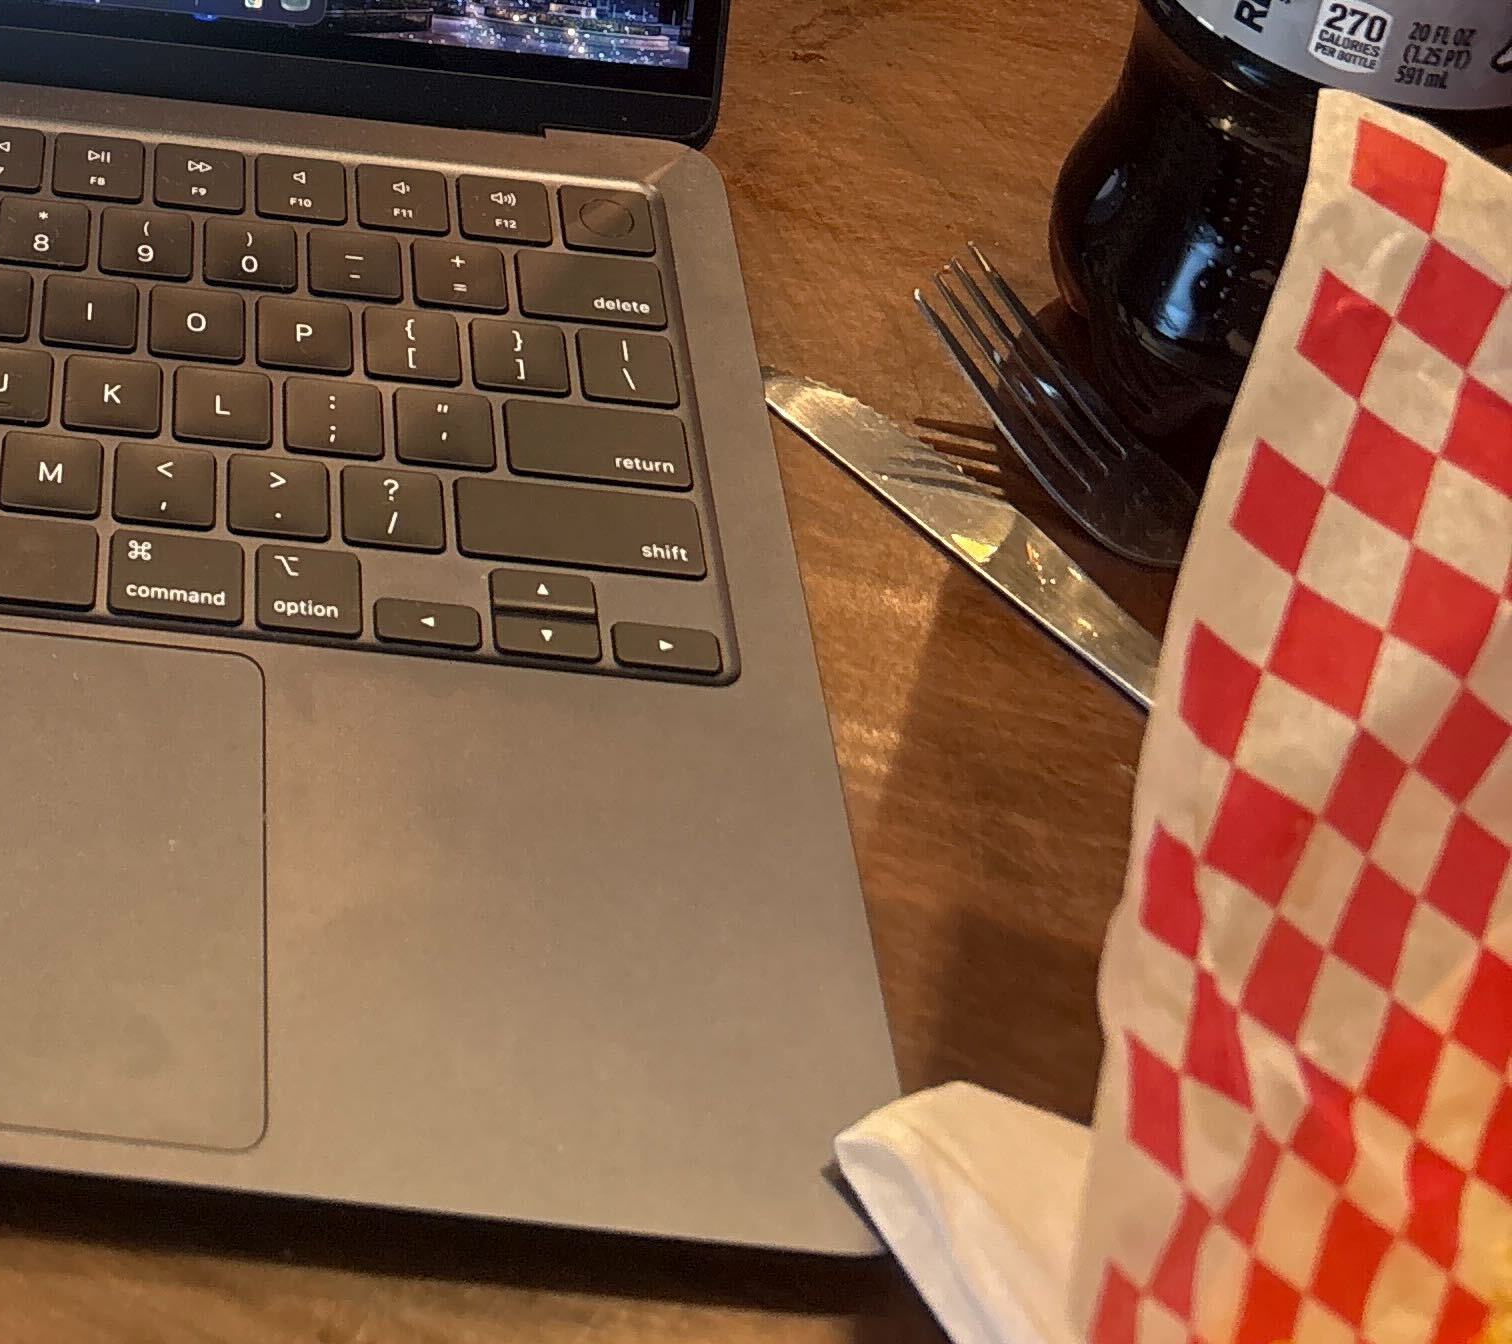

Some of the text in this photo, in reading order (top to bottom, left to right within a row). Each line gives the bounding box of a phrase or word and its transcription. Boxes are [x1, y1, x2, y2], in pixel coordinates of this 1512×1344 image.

[1324, 3, 1387, 43] 270
[1408, 21, 1430, 41] 20
[1318, 30, 1381, 57] CALORIES
[1314, 43, 1377, 70] PER BOTTLE
[594, 298, 649, 313] delete
[187, 313, 206, 331] O
[296, 324, 312, 341] P
[104, 384, 121, 403] K
[216, 395, 230, 415] L
[39, 462, 62, 483] M
[616, 458, 674, 473] return
[642, 544, 688, 561] shift
[126, 585, 225, 605] command
[274, 600, 338, 618] option
